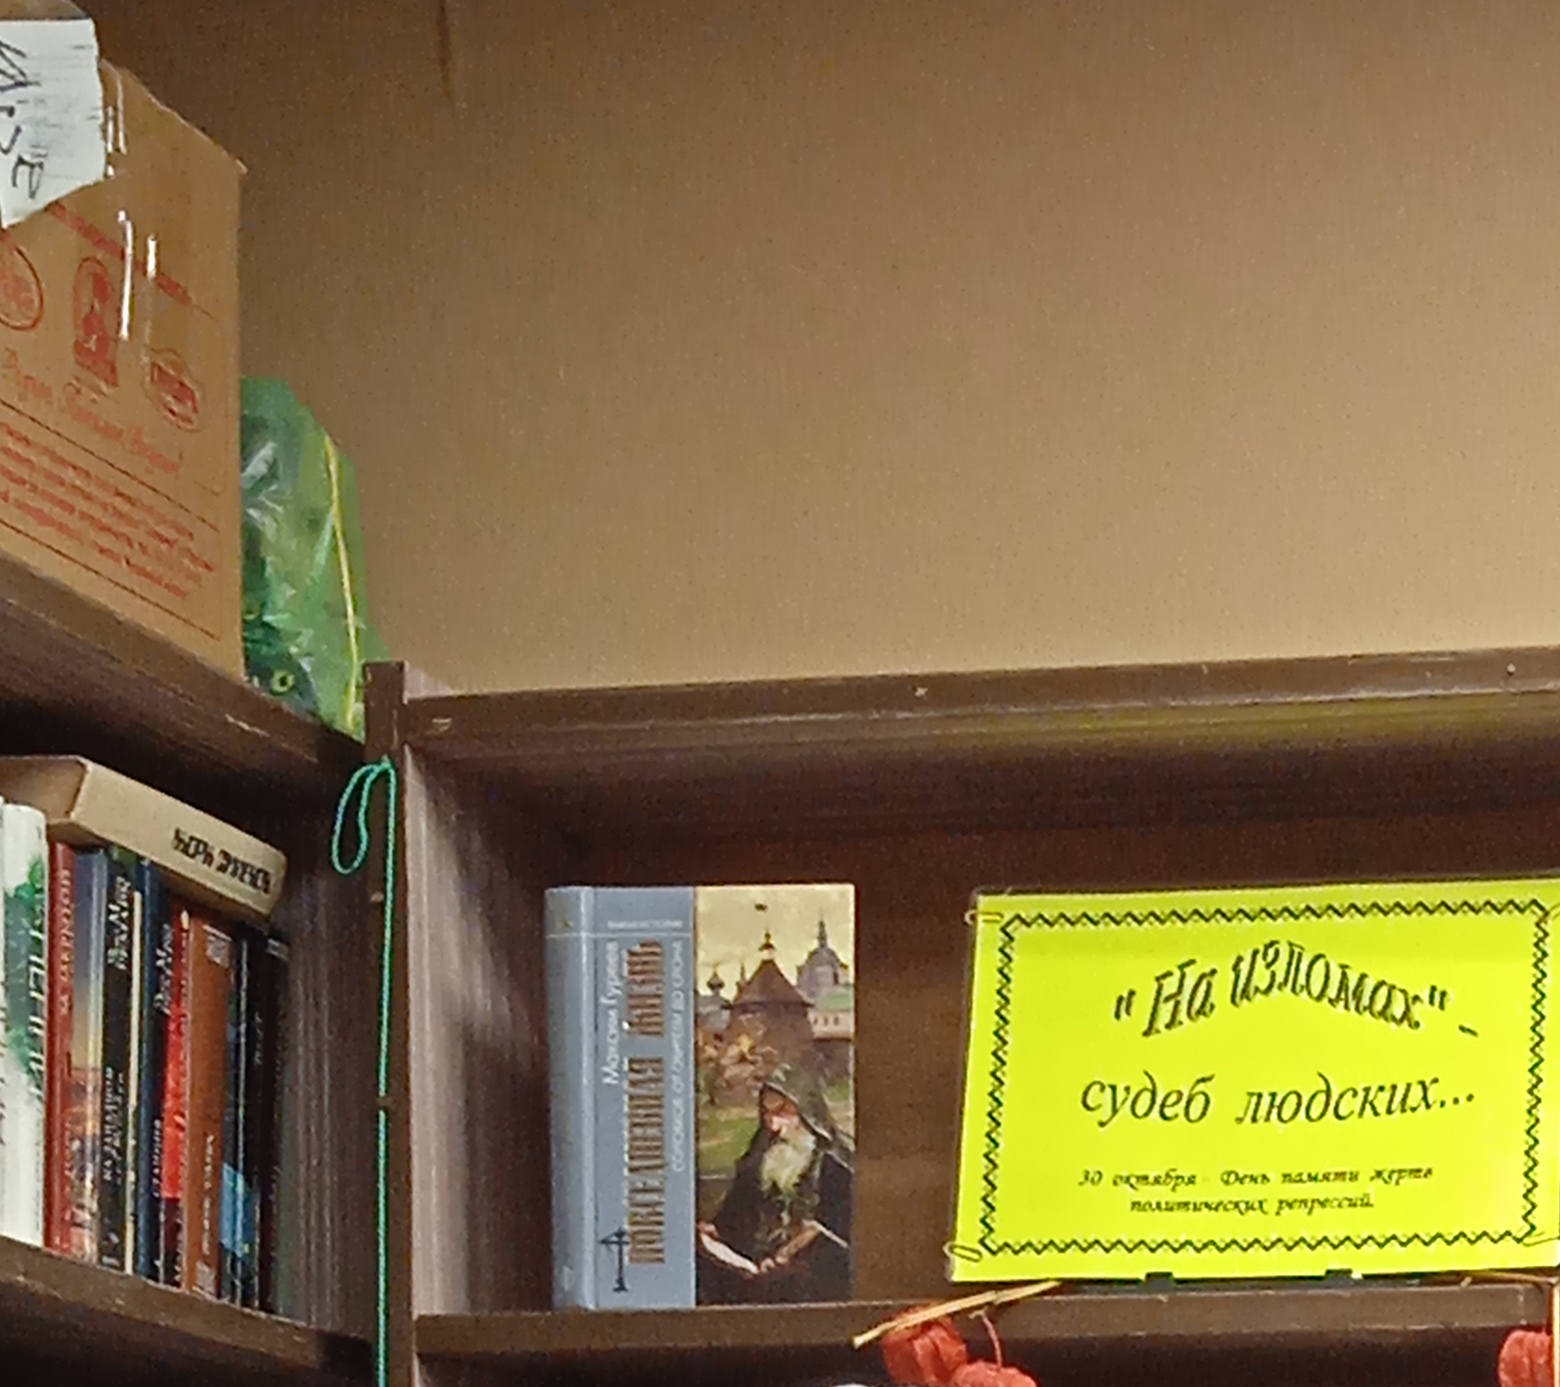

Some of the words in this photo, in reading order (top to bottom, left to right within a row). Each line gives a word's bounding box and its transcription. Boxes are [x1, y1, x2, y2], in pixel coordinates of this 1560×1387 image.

[1081, 1071, 1215, 1127] судеб
[1235, 1071, 1475, 1125] людских...
[1078, 1169, 1103, 1186] 30
[1112, 1169, 1197, 1191] октября
[1220, 1169, 1271, 1186] День
[1281, 1170, 1359, 1185] памяти
[1369, 1166, 1433, 1187] жертв
[1130, 1194, 1268, 1216] политических
